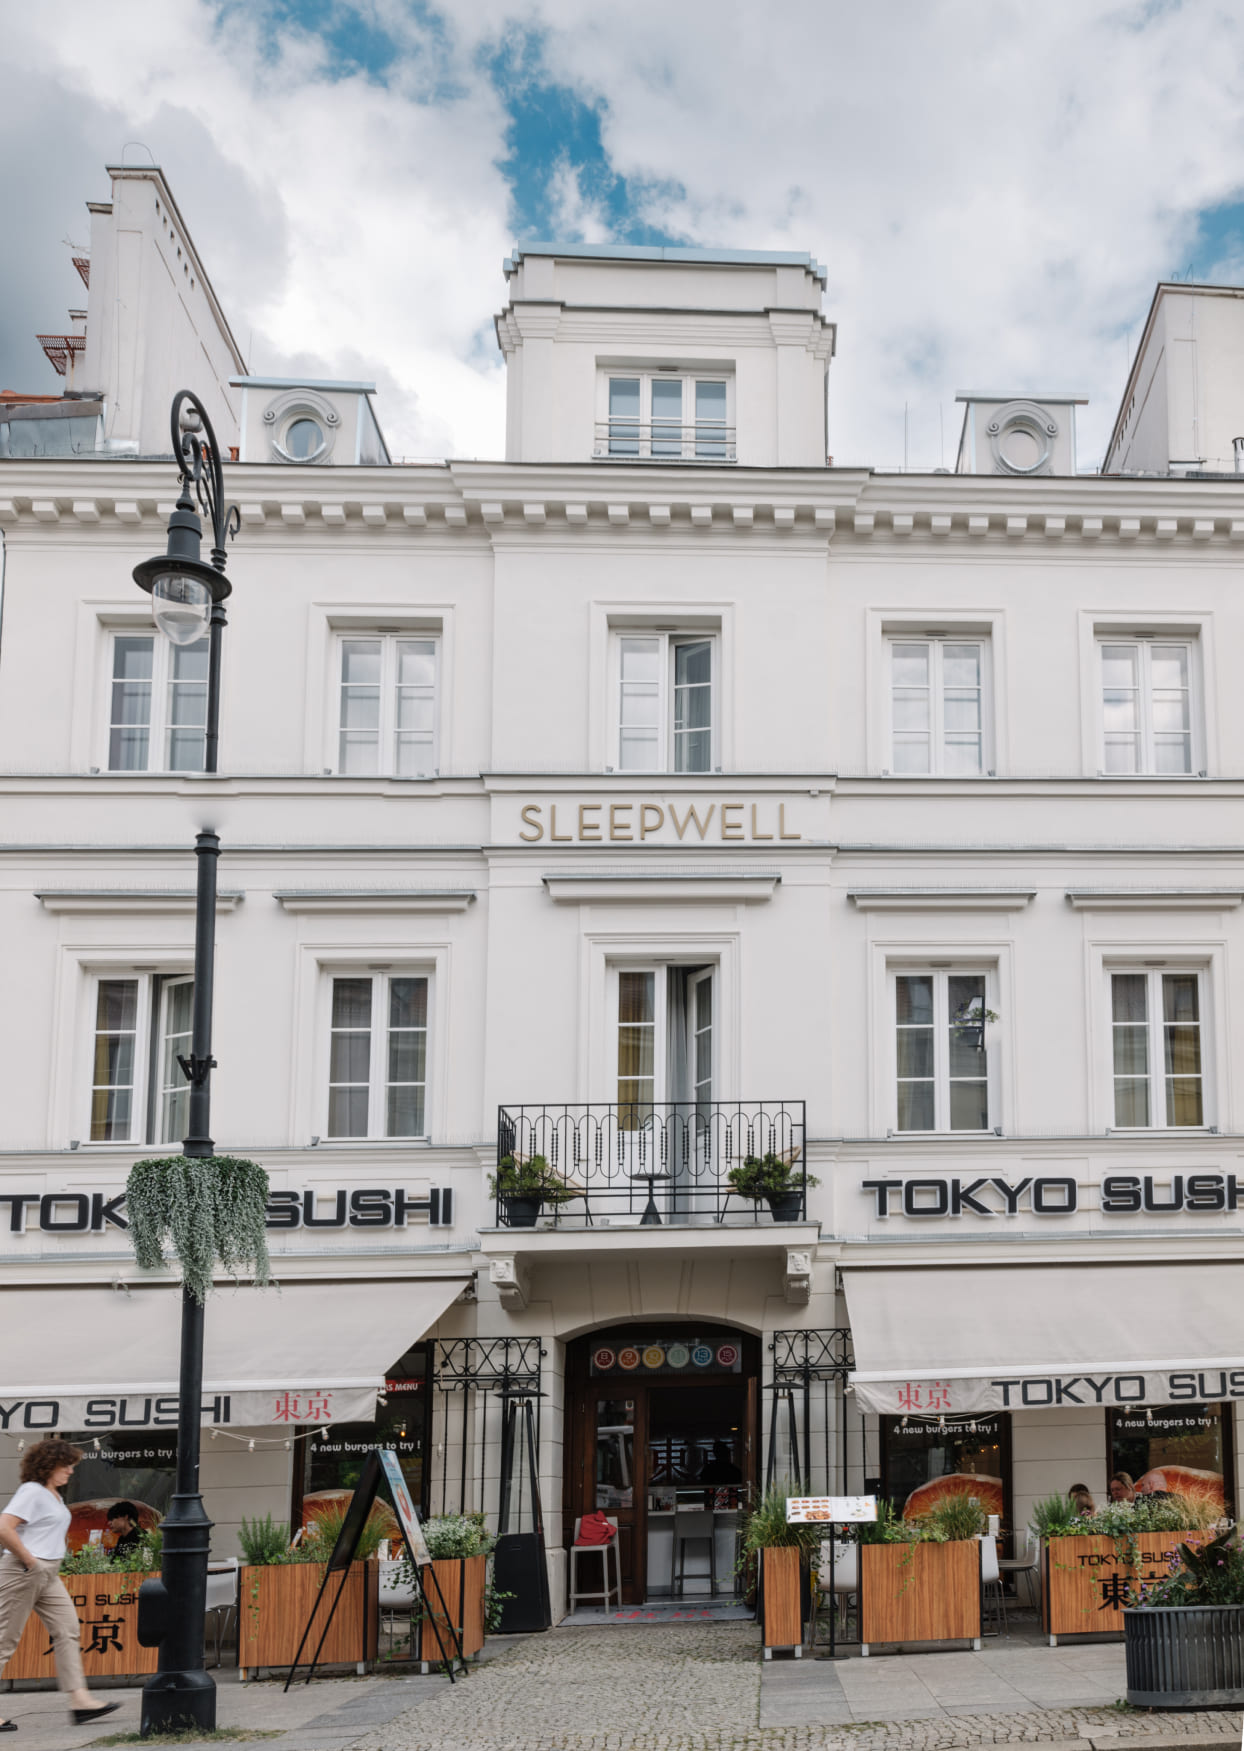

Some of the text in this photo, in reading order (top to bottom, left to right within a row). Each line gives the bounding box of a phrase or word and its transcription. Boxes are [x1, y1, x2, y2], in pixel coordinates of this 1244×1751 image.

[519, 803, 802, 842] SLEEPWELL
[264, 1187, 453, 1230] SUSHI
[861, 1177, 1077, 1218] TOKYO
[272, 1391, 334, 1422] 東京
[895, 1381, 952, 1411] 東京
[991, 1375, 1146, 1407] TOKYO
[84, 1395, 231, 1428] SUSHI
[1115, 1419, 1123, 1428] 4
[1125, 1420, 1145, 1428] new
[1148, 1416, 1184, 1430] burgers
[1185, 1417, 1196, 1426] to
[1197, 1416, 1212, 1428] try
[893, 1425, 900, 1435] 4
[902, 1426, 924, 1434] new
[926, 1424, 963, 1436] burgers
[977, 1423, 992, 1434] try
[80, 1452, 98, 1460] ew
[101, 1449, 142, 1461] burgers
[144, 1448, 155, 1458] to
[157, 1448, 173, 1460] try
[310, 1442, 317, 1452] 4
[320, 1444, 342, 1452] new
[345, 1442, 383, 1454] burgers
[386, 1441, 397, 1450] to
[400, 1440, 414, 1452] try
